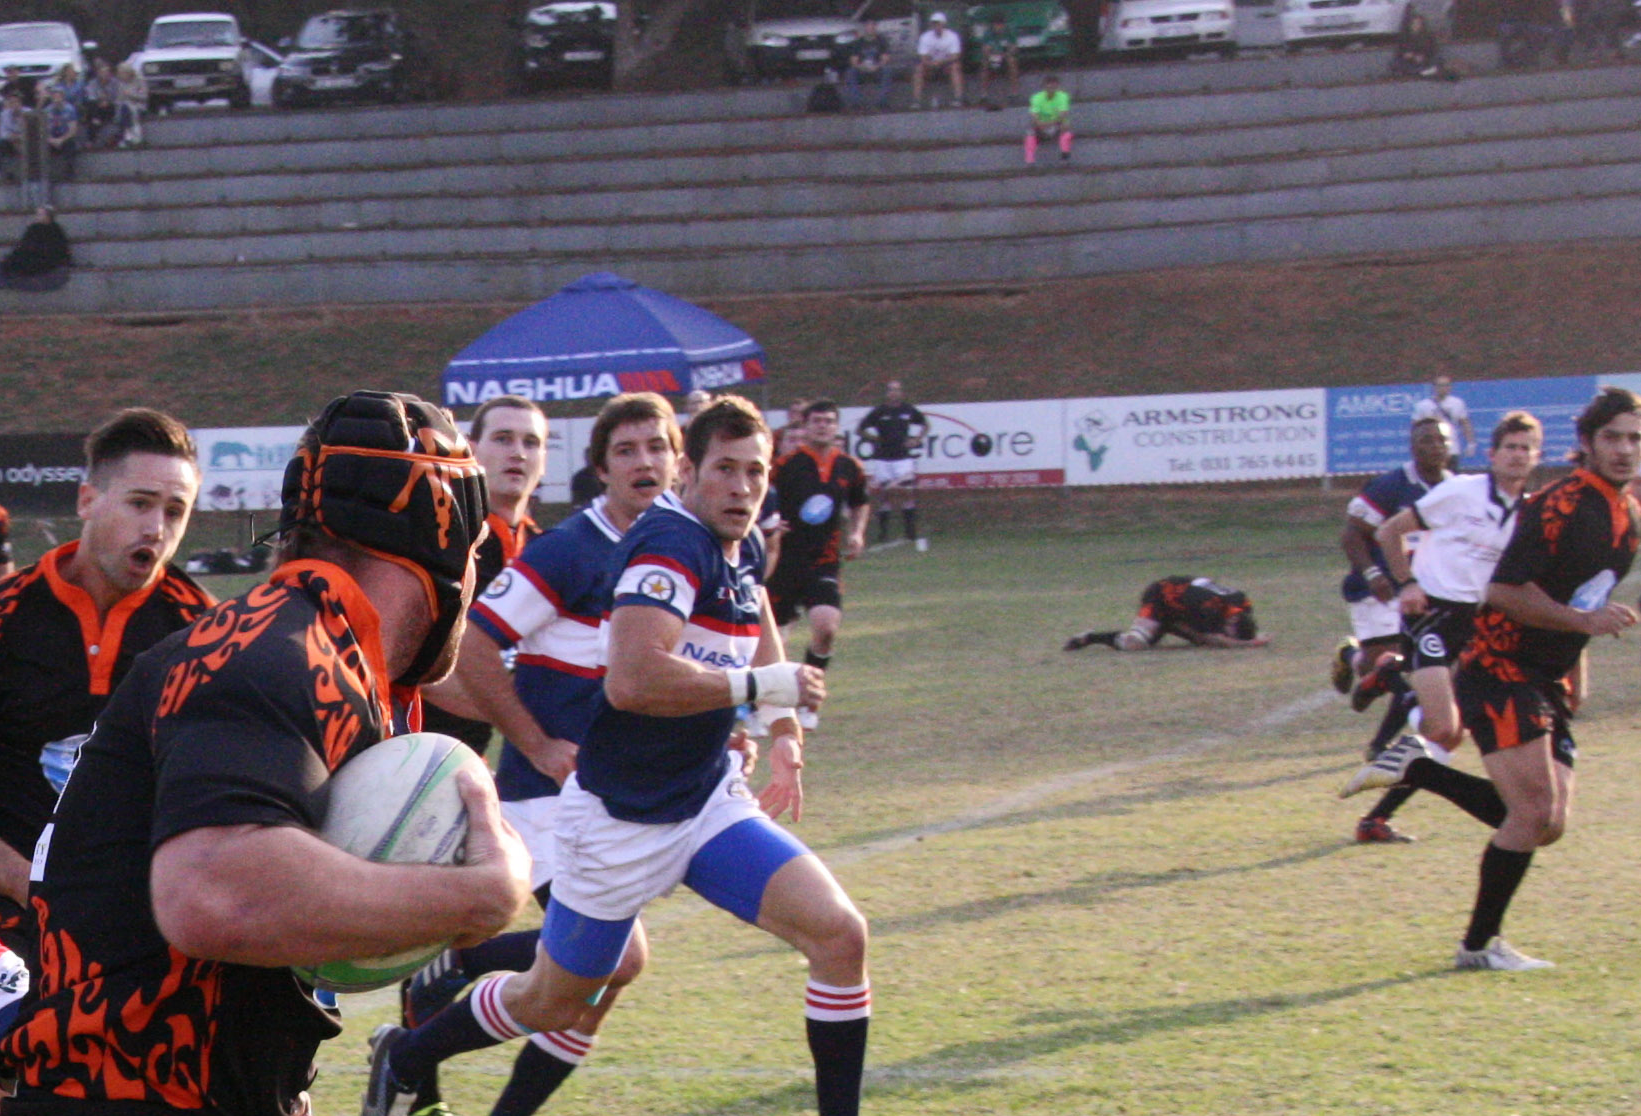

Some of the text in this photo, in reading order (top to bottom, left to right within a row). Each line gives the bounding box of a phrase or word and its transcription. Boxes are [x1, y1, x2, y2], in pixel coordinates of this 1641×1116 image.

[446, 373, 621, 404] NASHUA
[1122, 403, 1317, 427] ARMSTRONG
[1132, 424, 1316, 448] CONSTRUCTION
